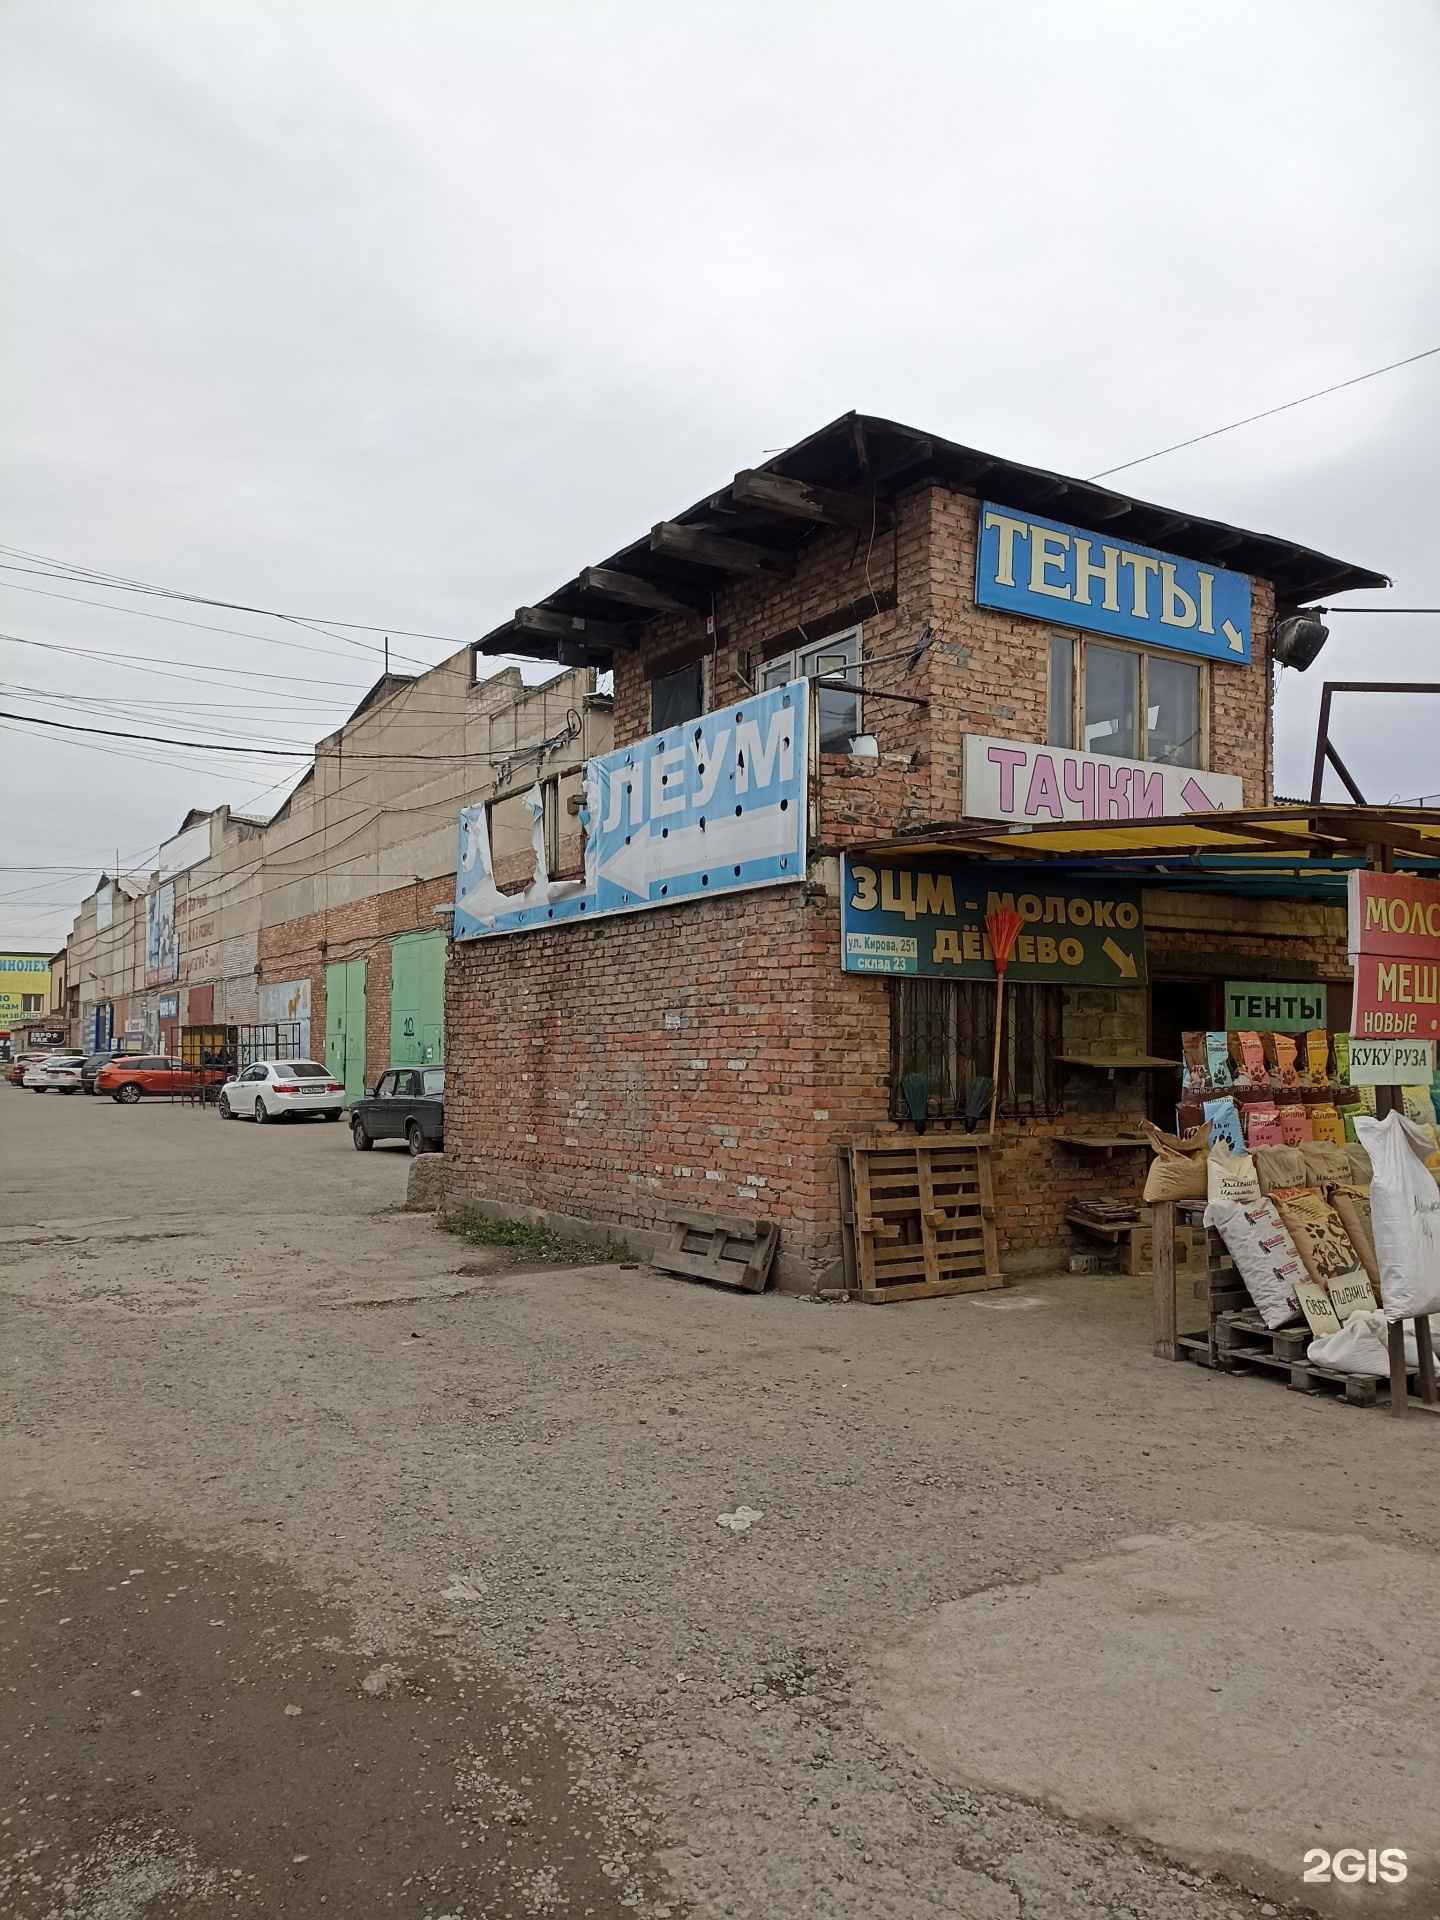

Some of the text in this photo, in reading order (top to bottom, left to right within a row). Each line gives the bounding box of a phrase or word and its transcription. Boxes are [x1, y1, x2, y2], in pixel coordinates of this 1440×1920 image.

[984, 511, 1217, 635] ТЕНТЫ
[603, 706, 796, 833] ЛЕУМ
[987, 747, 1164, 822] ТАЧКИ
[850, 866, 957, 921] ЗЦМ
[857, 957, 891, 971] склад
[404, 1017, 414, 1033] 10
[1230, 994, 1323, 1021] ТЕНТЫ
[1305, 1296, 1333, 1316] ОВЕС
